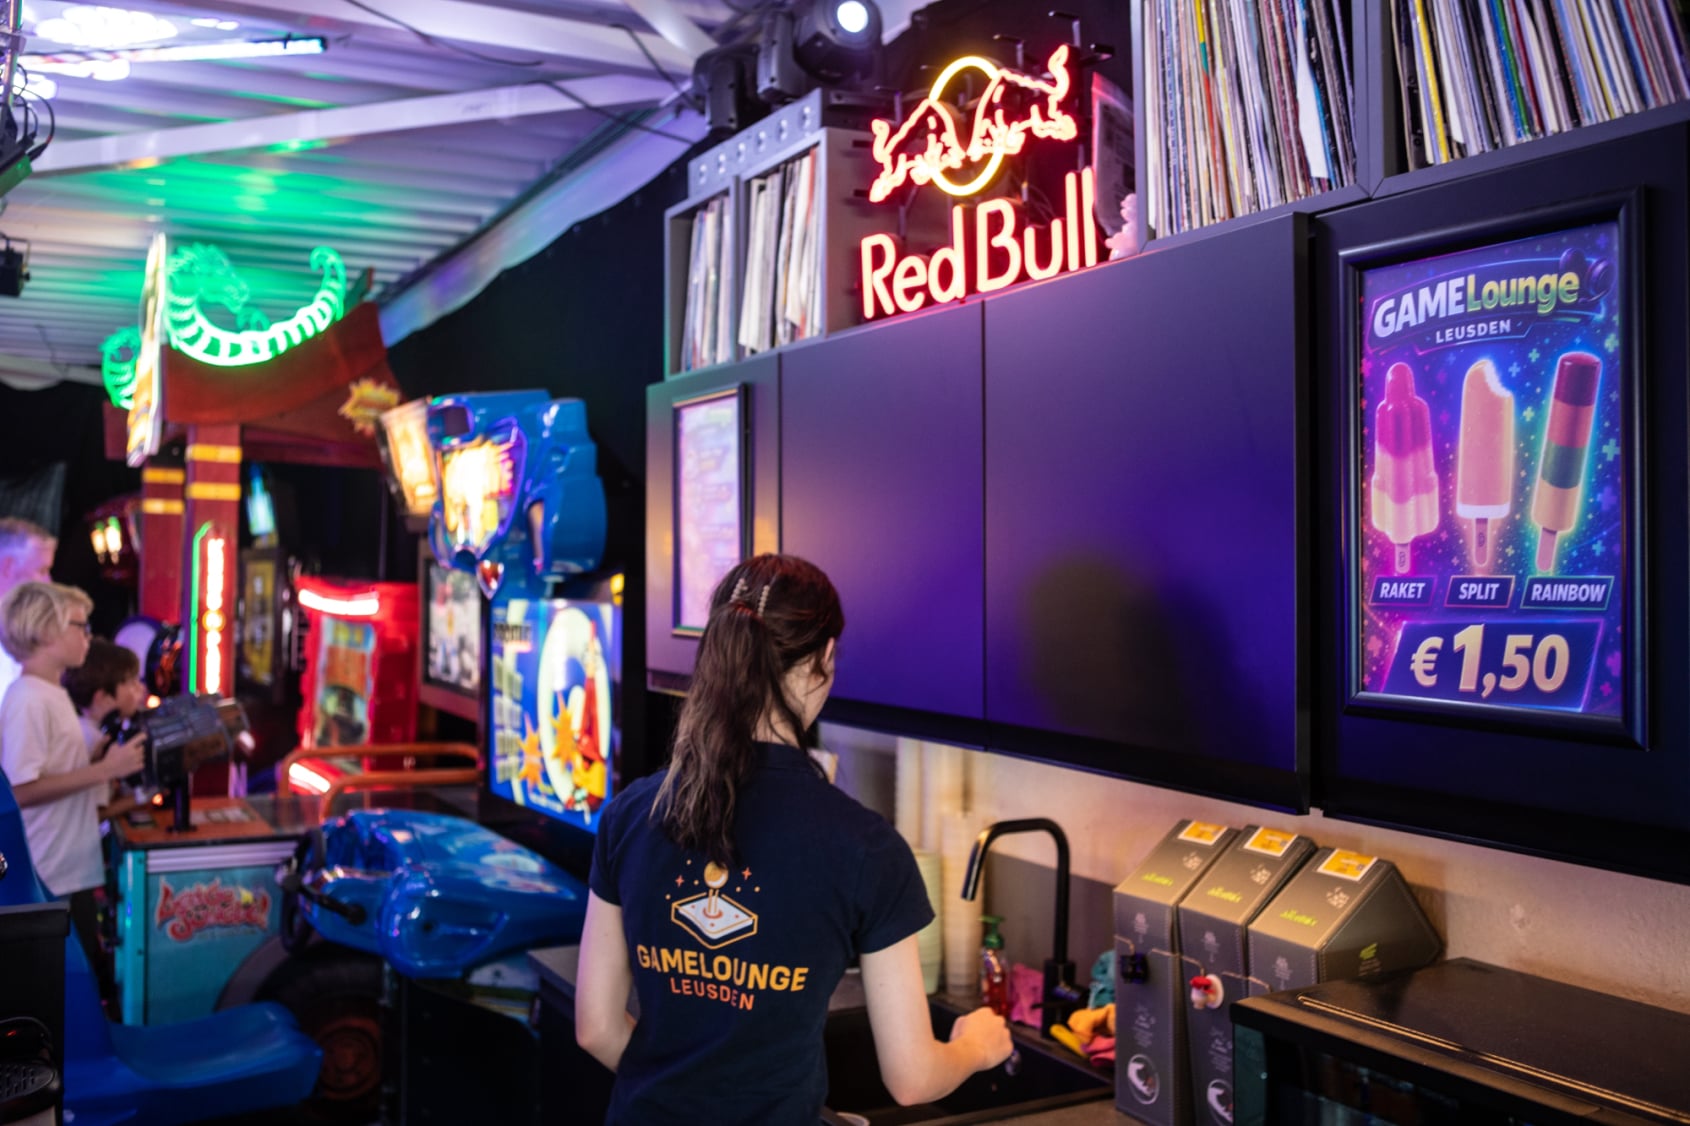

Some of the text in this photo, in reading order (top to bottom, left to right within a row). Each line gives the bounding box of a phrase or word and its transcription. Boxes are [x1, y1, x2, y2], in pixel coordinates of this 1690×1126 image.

[861, 166, 1097, 319] Red Bull
[1435, 319, 1511, 344] LEUSDEN
[1379, 582, 1425, 599] RAKET
[1459, 582, 1500, 600] SPLIT
[1531, 583, 1607, 603] RAINBOW
[1453, 624, 1570, 698] 1,50
[636, 944, 809, 992] GAMELOUNGE
[670, 977, 755, 1010] LEUSDEN
